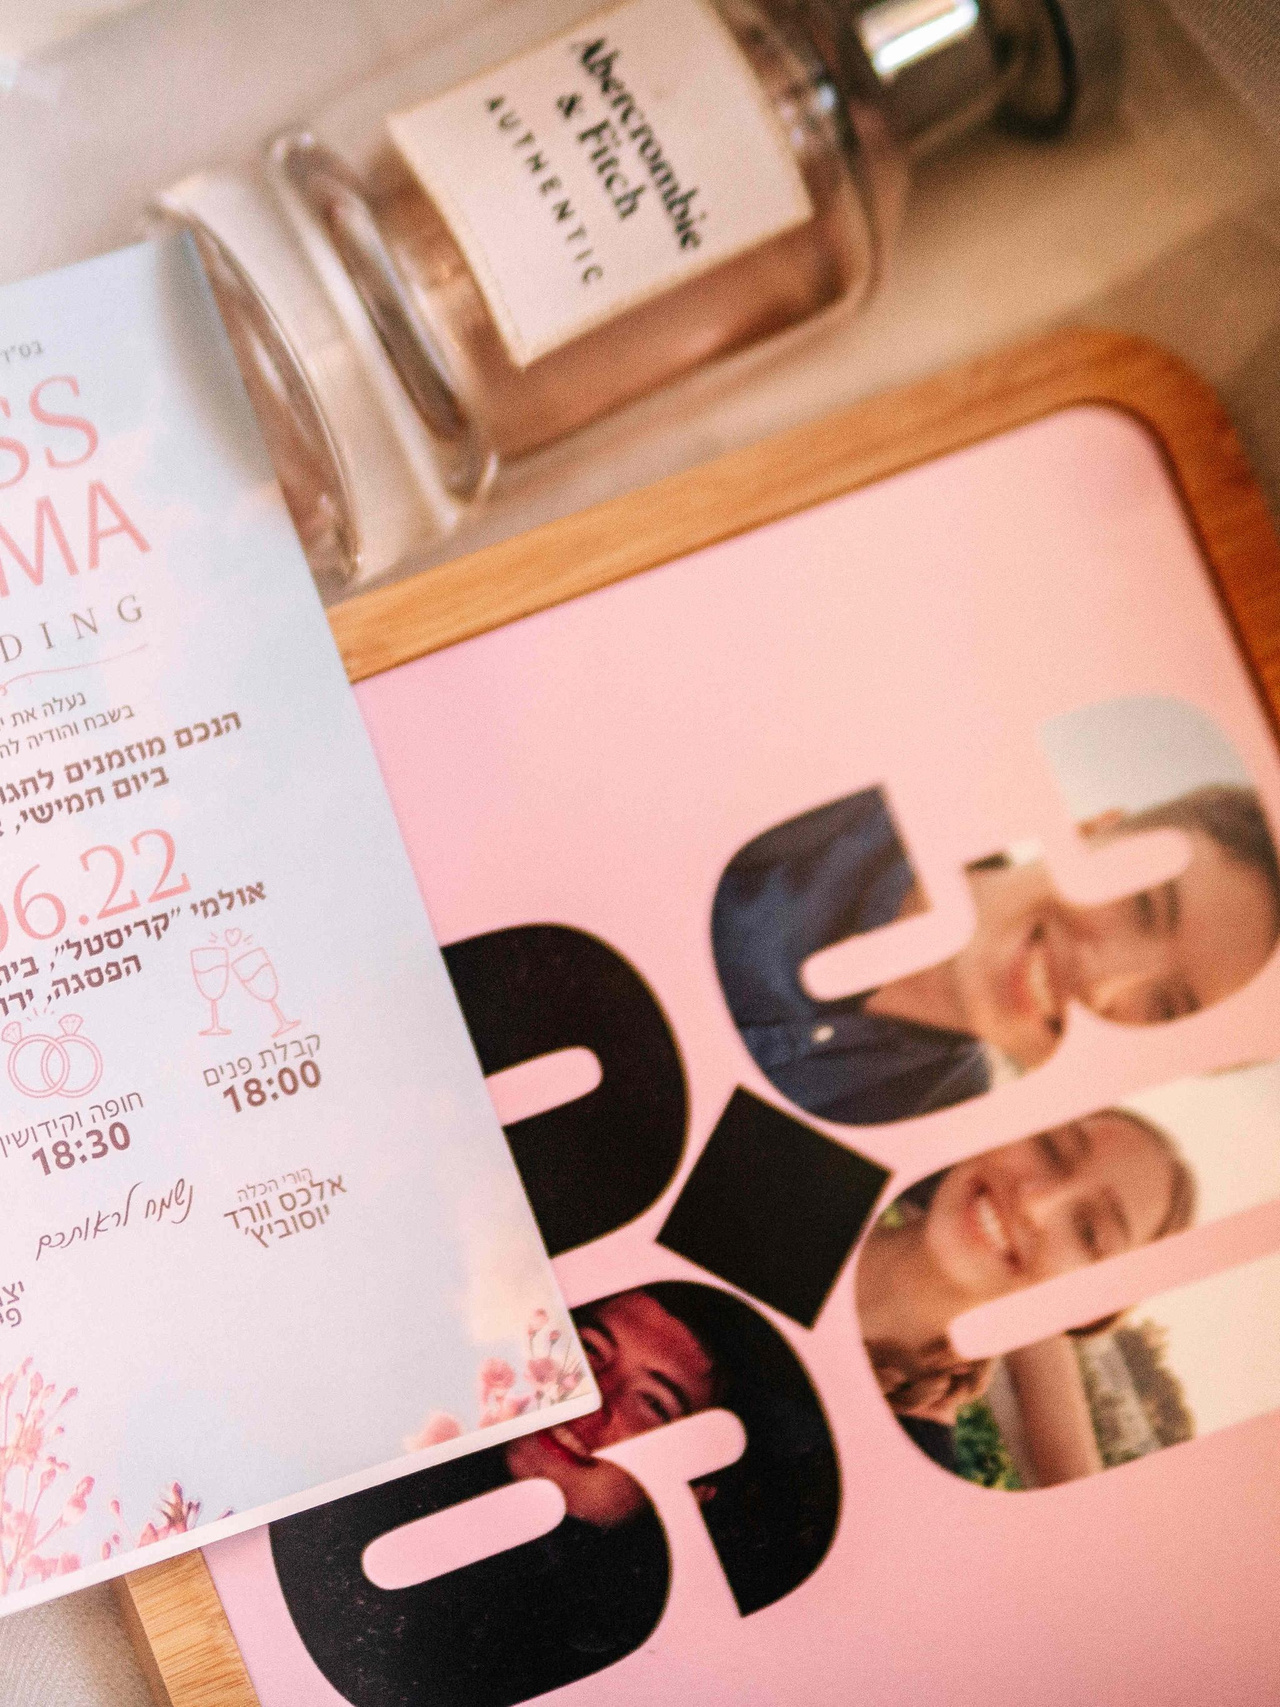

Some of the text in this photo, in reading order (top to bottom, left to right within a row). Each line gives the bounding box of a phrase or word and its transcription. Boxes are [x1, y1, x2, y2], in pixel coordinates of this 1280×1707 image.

[556, 92, 647, 221] & Fitch
[574, 36, 707, 256] Abercrombie
[486, 96, 603, 286] AUTHENTIC
[10, 707, 37, 727] את
[41, 692, 86, 717] נעלה
[83, 704, 134, 731] בשבח
[26, 721, 79, 749] והודיה
[173, 711, 241, 748] הנכם
[63, 736, 166, 783] מוזמנים
[111, 766, 169, 799] ביום
[15, 786, 105, 833] חמישי,
[189, 881, 266, 918] אולמי
[46, 954, 141, 1003] הפסגה,
[202, 1033, 320, 1087] קבלת פנים
[88, 1091, 143, 1123] חופה
[222, 1059, 321, 1112] 18:00
[31, 1121, 130, 1175] 18:30
[223, 1174, 346, 1229] אלכס וורד
[236, 1167, 313, 1202] הורי הכלה
[35, 1178, 193, 1261] נשמח לראותכם
